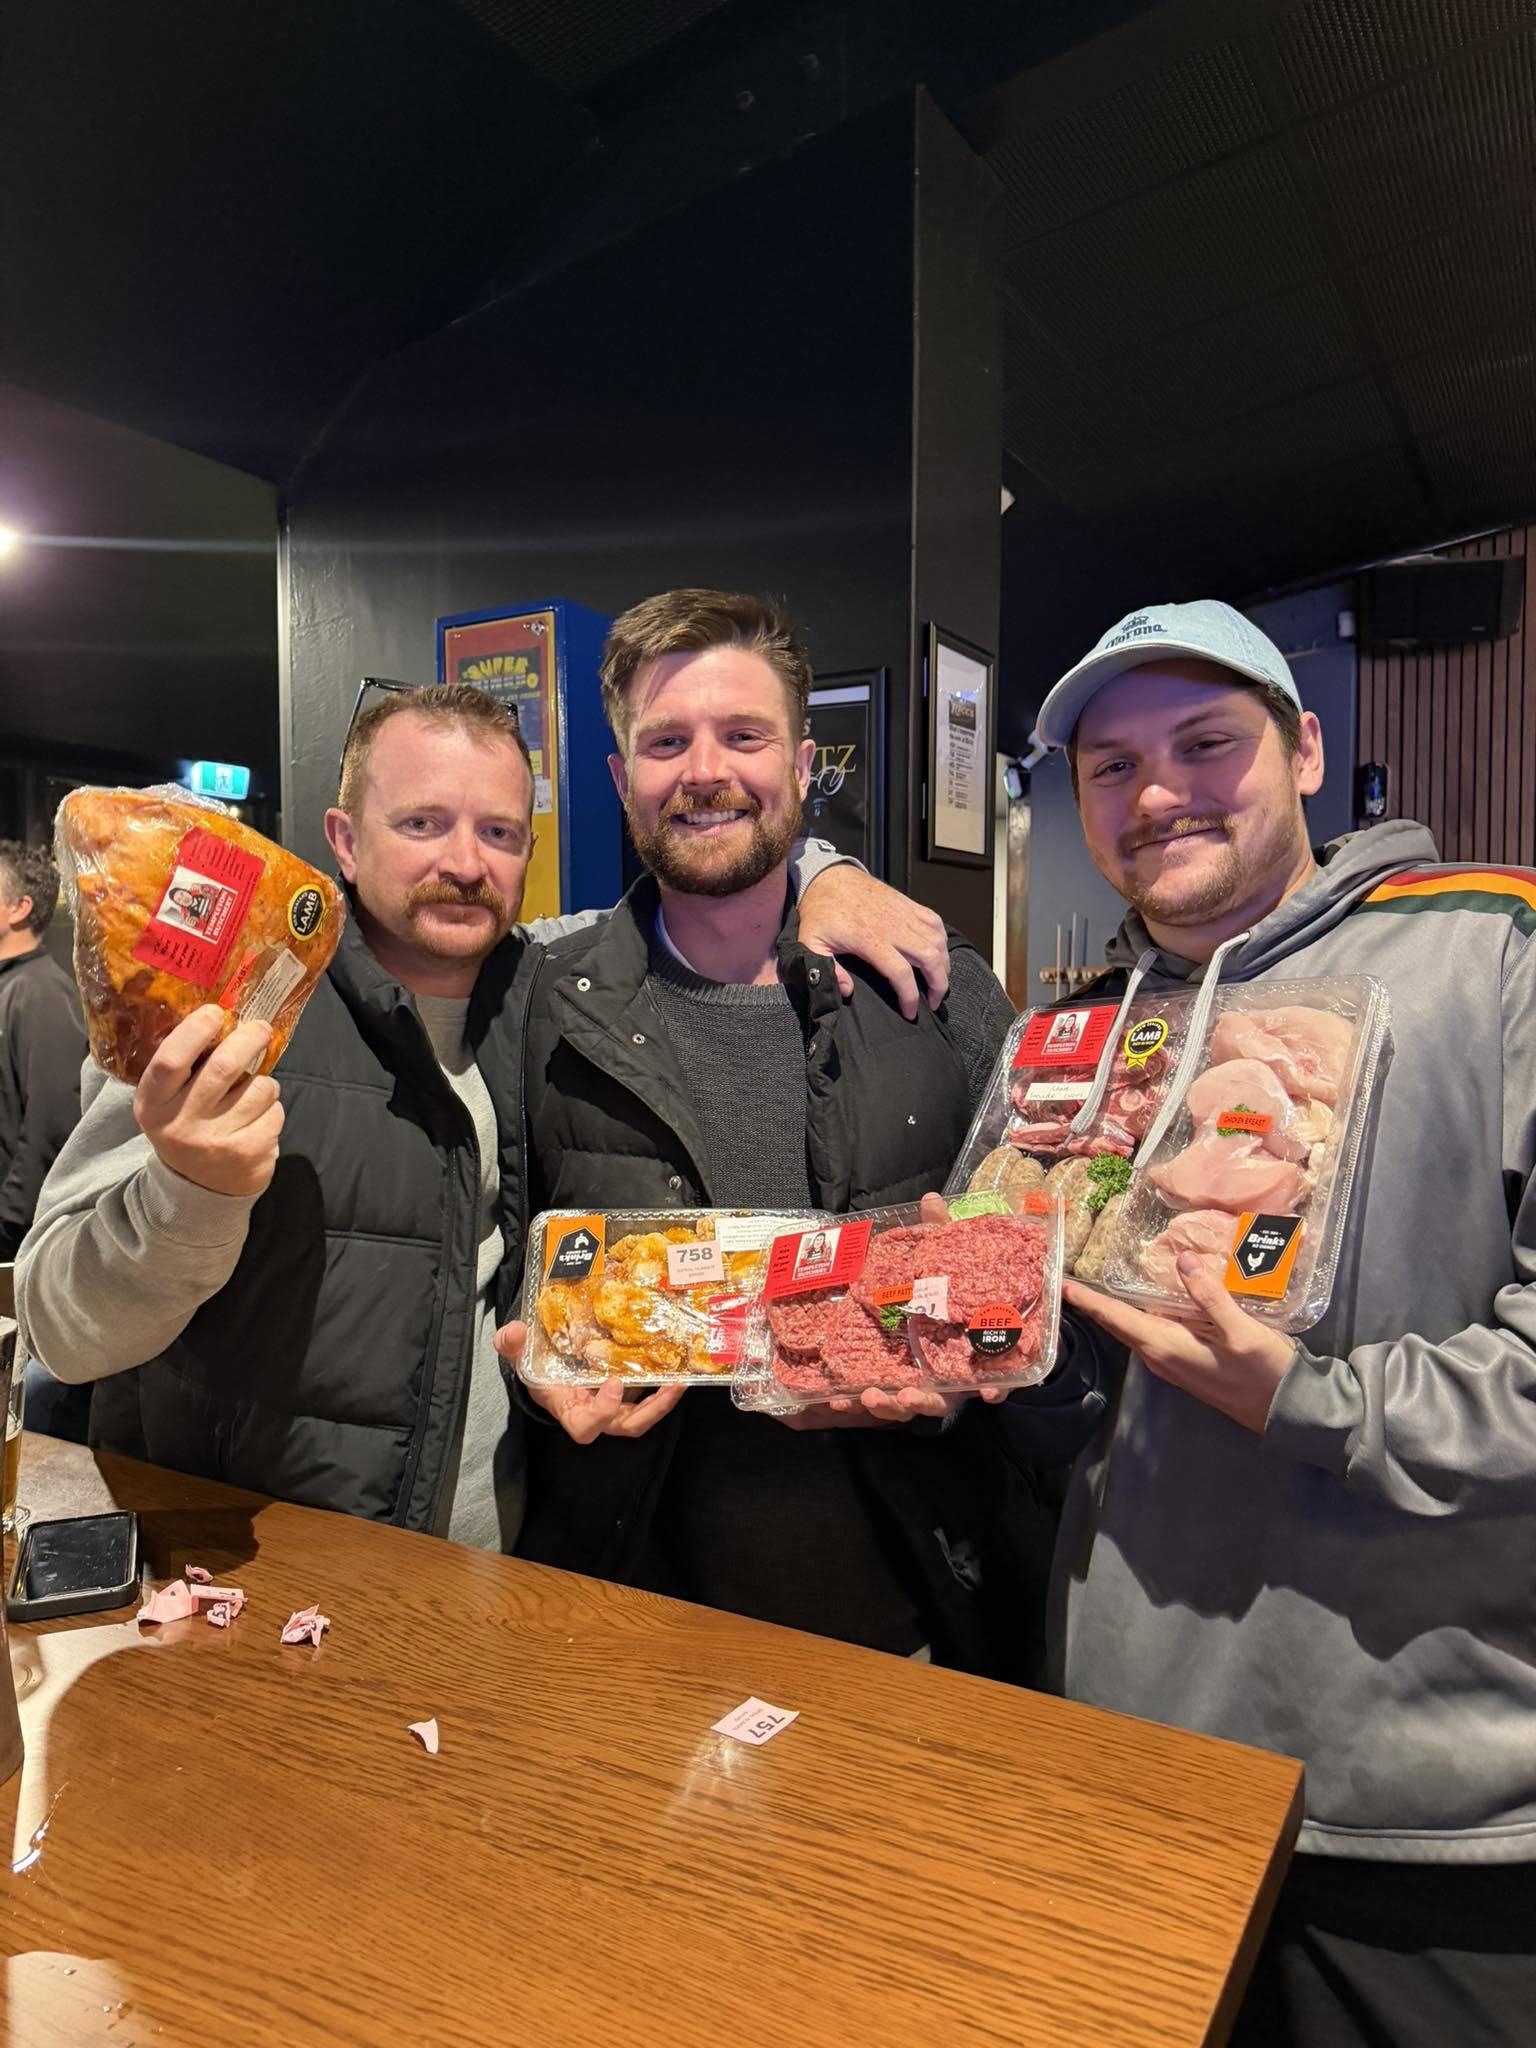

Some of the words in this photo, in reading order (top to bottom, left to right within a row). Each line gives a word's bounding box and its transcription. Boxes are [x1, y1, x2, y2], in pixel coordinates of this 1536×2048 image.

[1105, 624, 1168, 649] Corona
[205, 890, 229, 936] TEMPLETON
[212, 896, 234, 938] BUTCHERY
[297, 891, 318, 933] LAMB
[1130, 1030, 1162, 1042] LAMB
[1244, 1117, 1266, 1127] BREAST
[676, 1247, 713, 1263] 758
[797, 1262, 830, 1273] TEMPLETON
[797, 1268, 828, 1278] BUTCHERY
[897, 1287, 913, 1297] PATT
[980, 1317, 1012, 1327] BEEF
[982, 1335, 1006, 1343] IRON
[748, 1714, 786, 1738] 757
